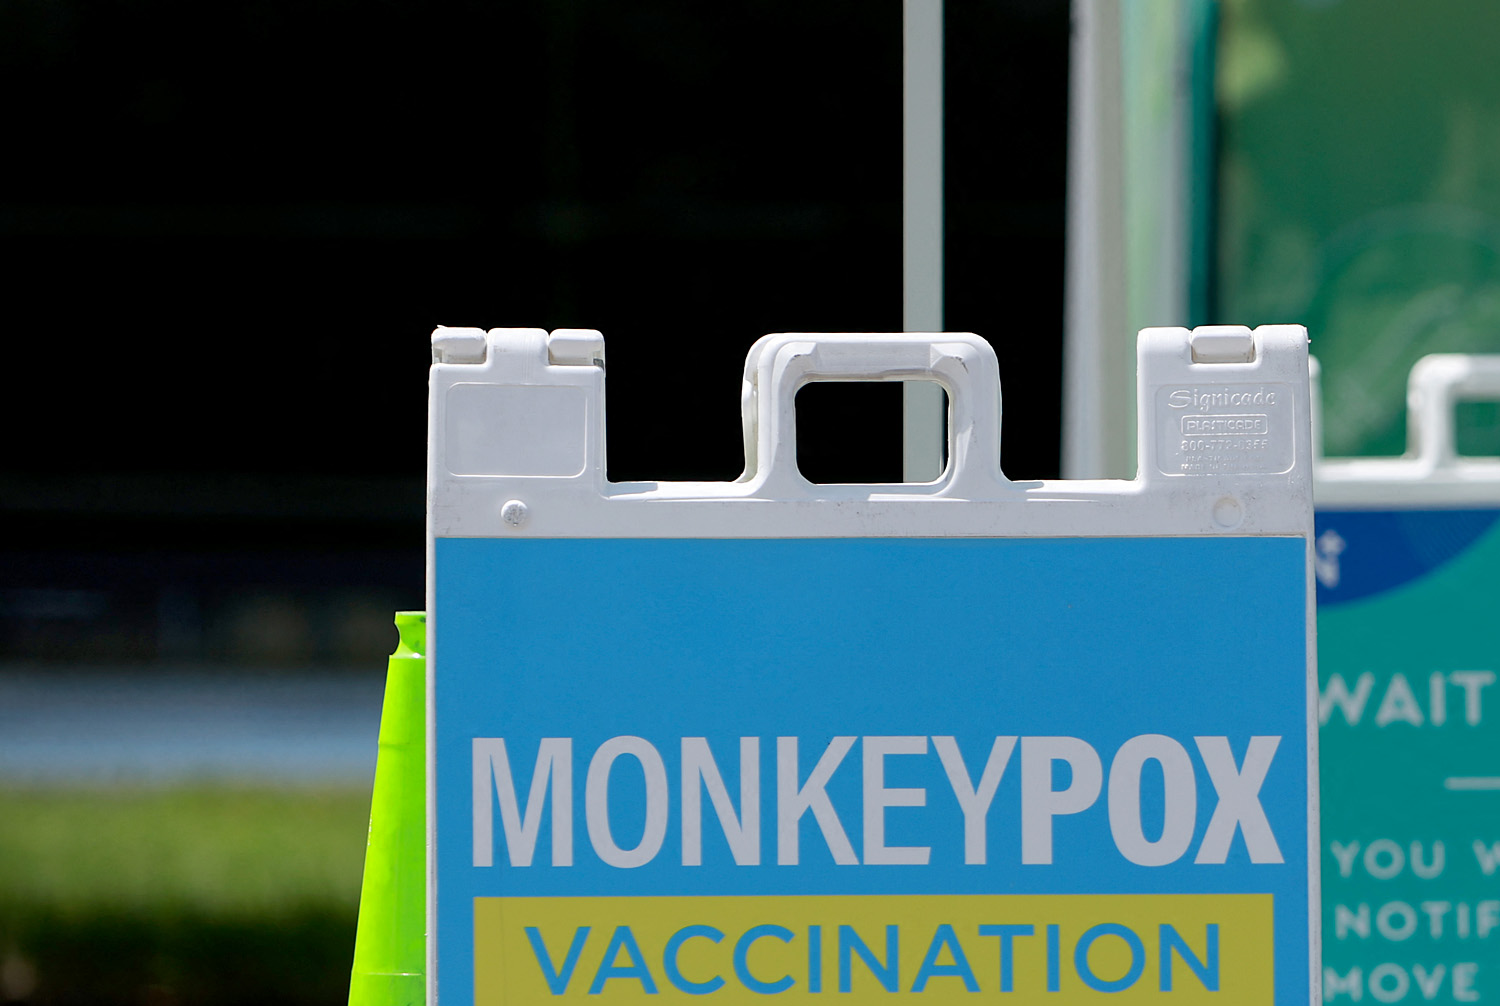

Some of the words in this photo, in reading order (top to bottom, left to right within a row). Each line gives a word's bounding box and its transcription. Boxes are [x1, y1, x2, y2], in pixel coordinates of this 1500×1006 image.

[1168, 387, 1276, 412] Signicade
[1186, 419, 1261, 431] PLASTICADE
[1319, 670, 1496, 727] WAIT
[471, 733, 1286, 869] MONKEYPOX
[1330, 837, 1446, 881] YOU
[523, 922, 1220, 996] VACCINATION
[1322, 961, 1481, 1004] MOVE
